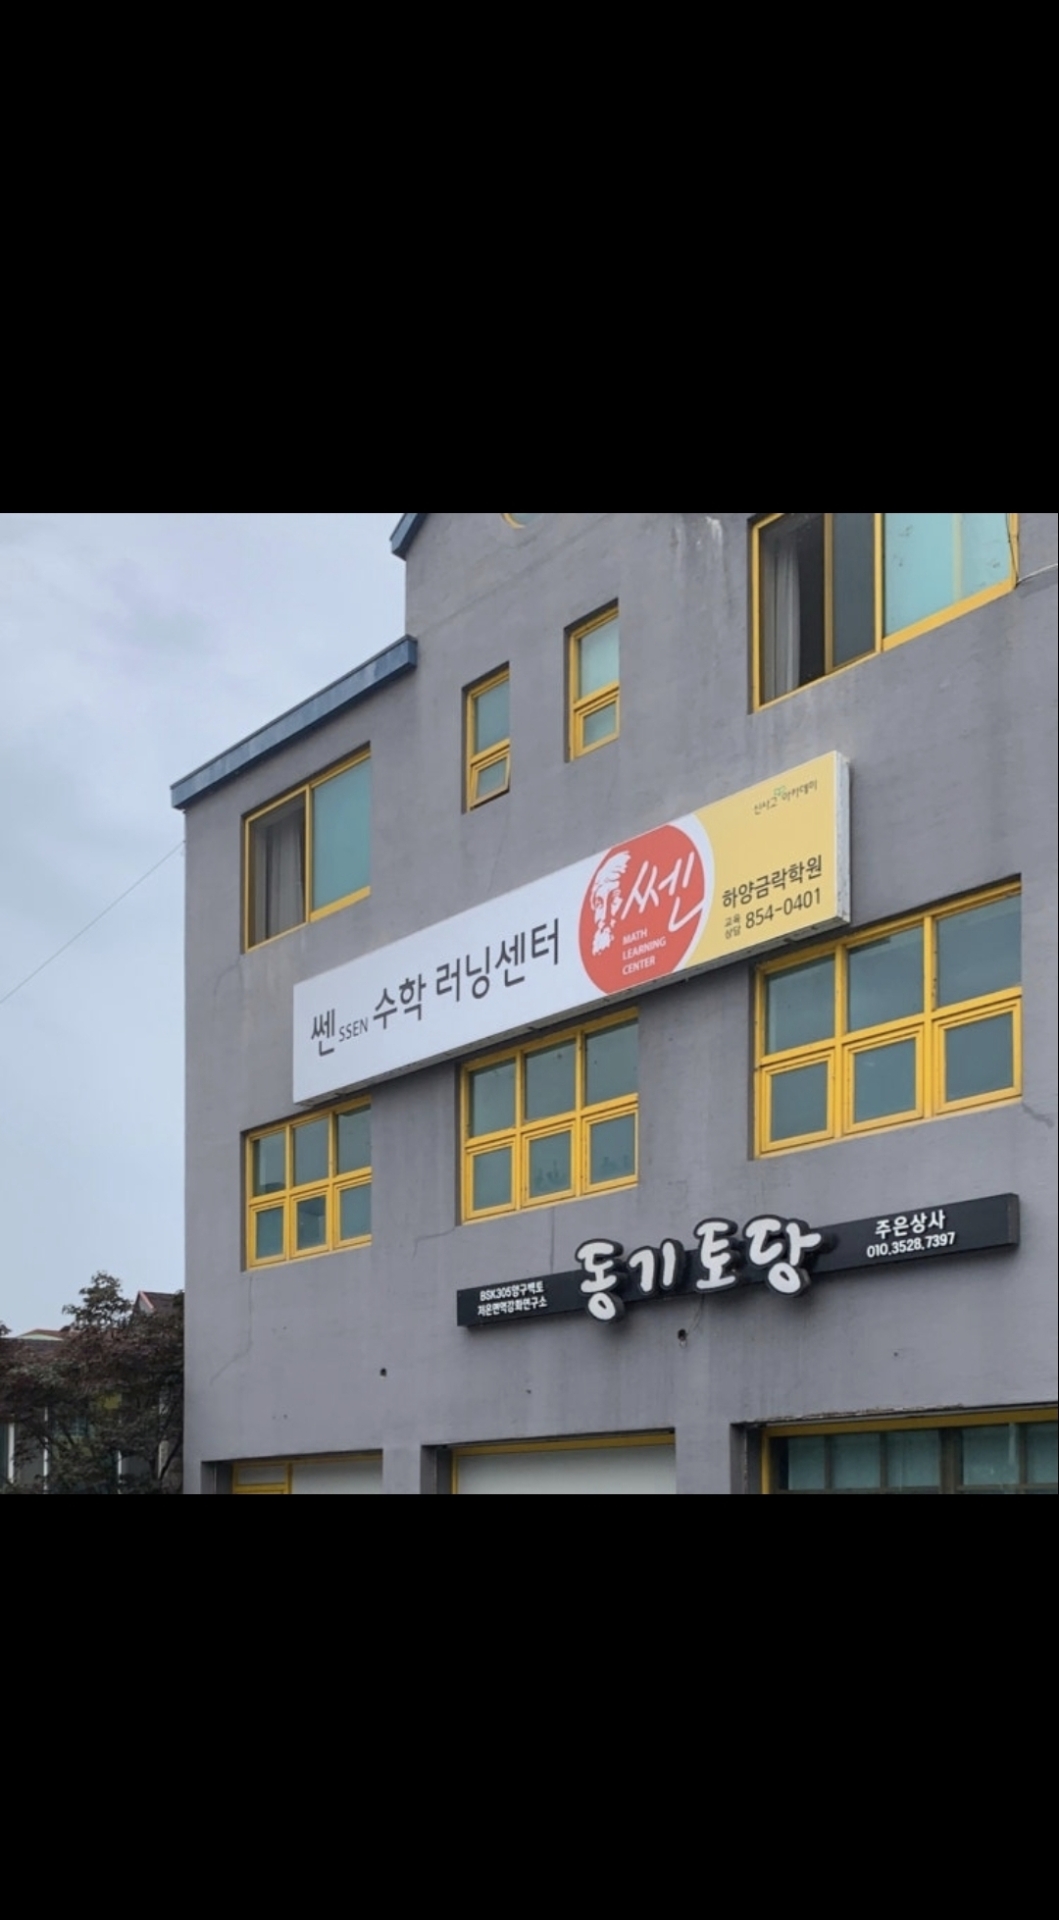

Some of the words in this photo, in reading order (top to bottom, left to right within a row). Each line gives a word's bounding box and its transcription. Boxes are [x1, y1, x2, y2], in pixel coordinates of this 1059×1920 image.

[722, 854, 822, 909] 하양금락학원
[745, 887, 821, 930] 854-0401
[622, 927, 648, 946] MATH
[622, 936, 667, 961] LEARNING
[622, 954, 656, 976] CENTER
[310, 1008, 336, 1057] 쎈
[338, 1016, 369, 1042] SSEN
[373, 973, 427, 1031] 수학
[435, 917, 559, 1002] 러닝센터
[875, 1209, 946, 1240] 주은상사
[866, 1231, 956, 1258] 010.3528.7397
[577, 1217, 822, 1321] 동기토당
